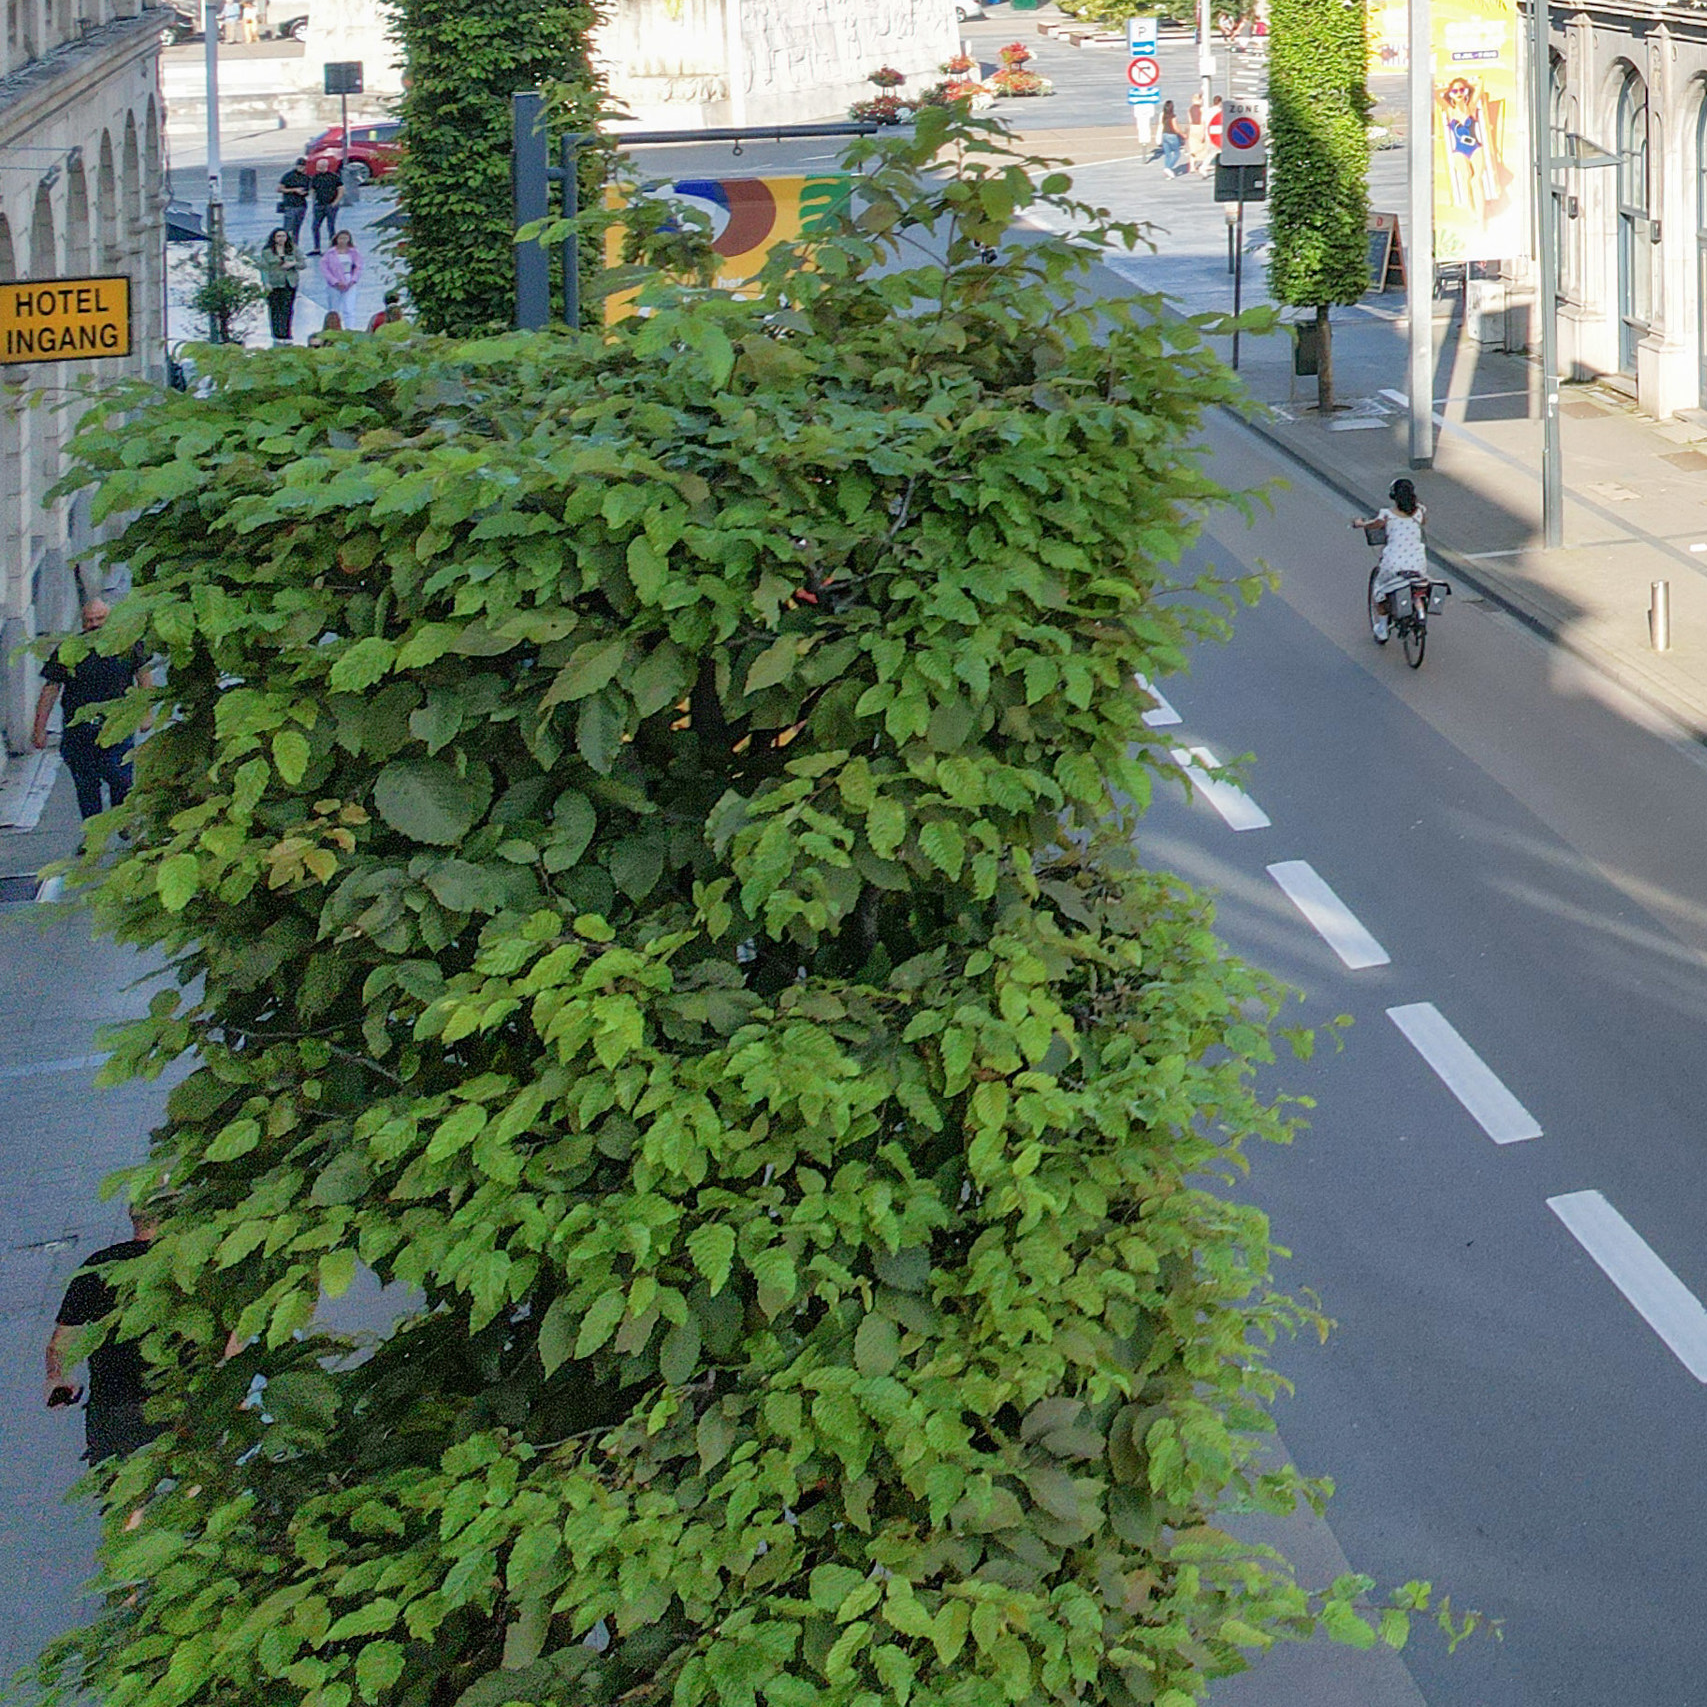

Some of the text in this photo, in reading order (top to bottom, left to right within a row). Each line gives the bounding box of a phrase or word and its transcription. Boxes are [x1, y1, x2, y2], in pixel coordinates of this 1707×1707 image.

[1138, 26, 1147, 37] P
[1229, 105, 1259, 114] ZONE
[15, 288, 109, 317] HOTEL
[7, 323, 118, 354] INGANG
